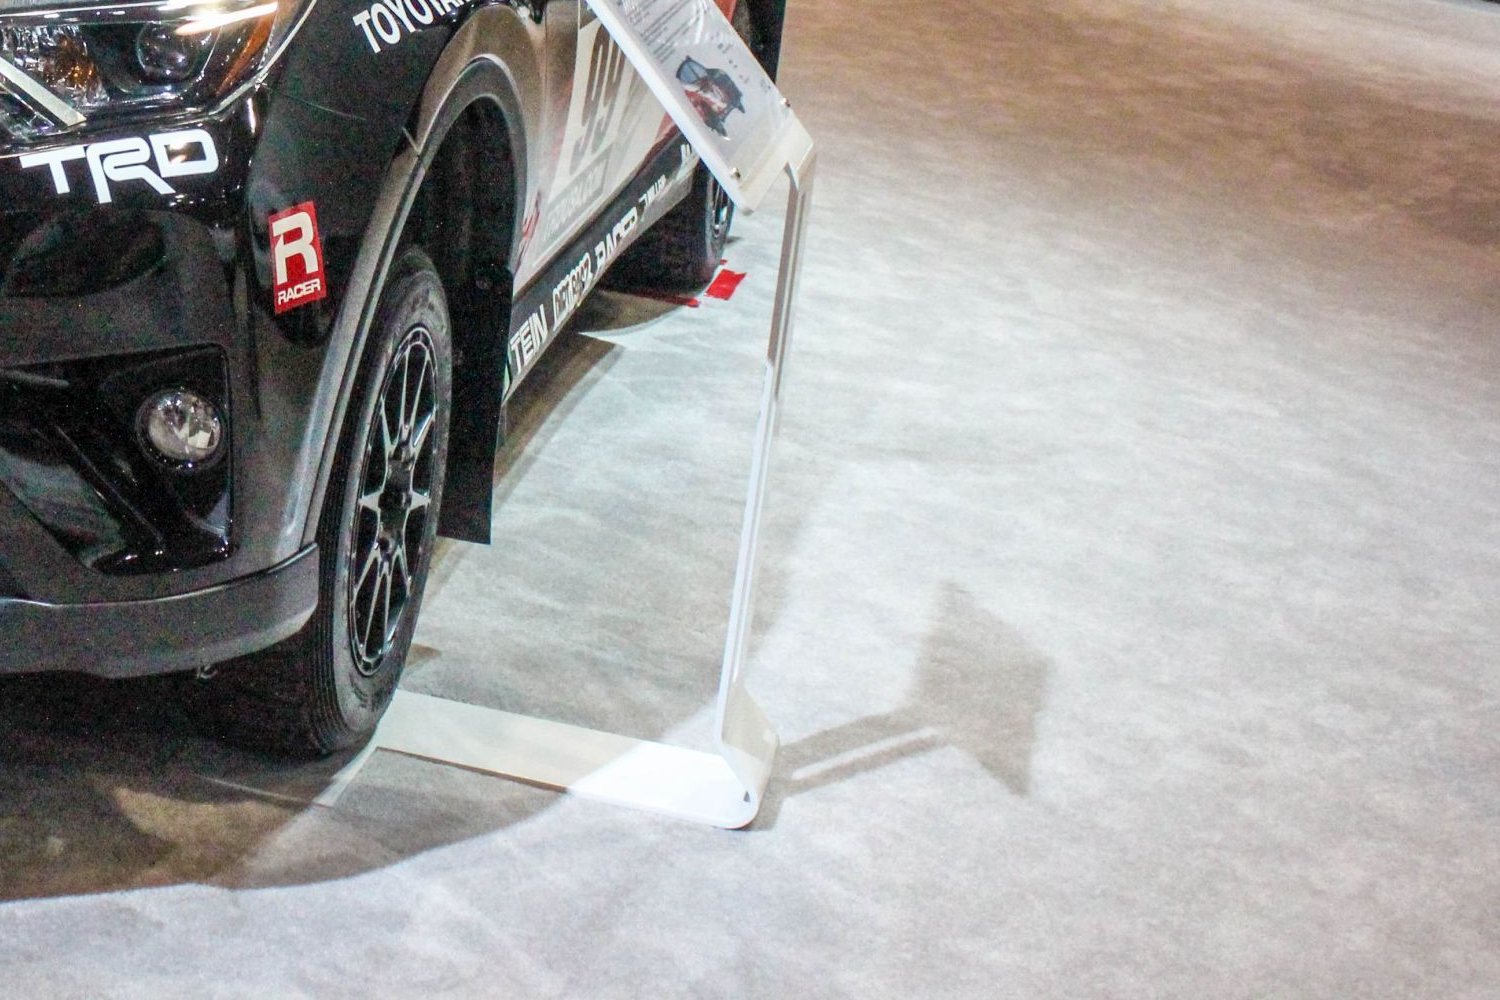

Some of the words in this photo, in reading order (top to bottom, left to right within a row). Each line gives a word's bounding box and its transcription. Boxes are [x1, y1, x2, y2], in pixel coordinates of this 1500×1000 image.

[20, 128, 219, 203] TRD
[277, 278, 321, 306] RACER
[509, 303, 549, 375] TEIN
